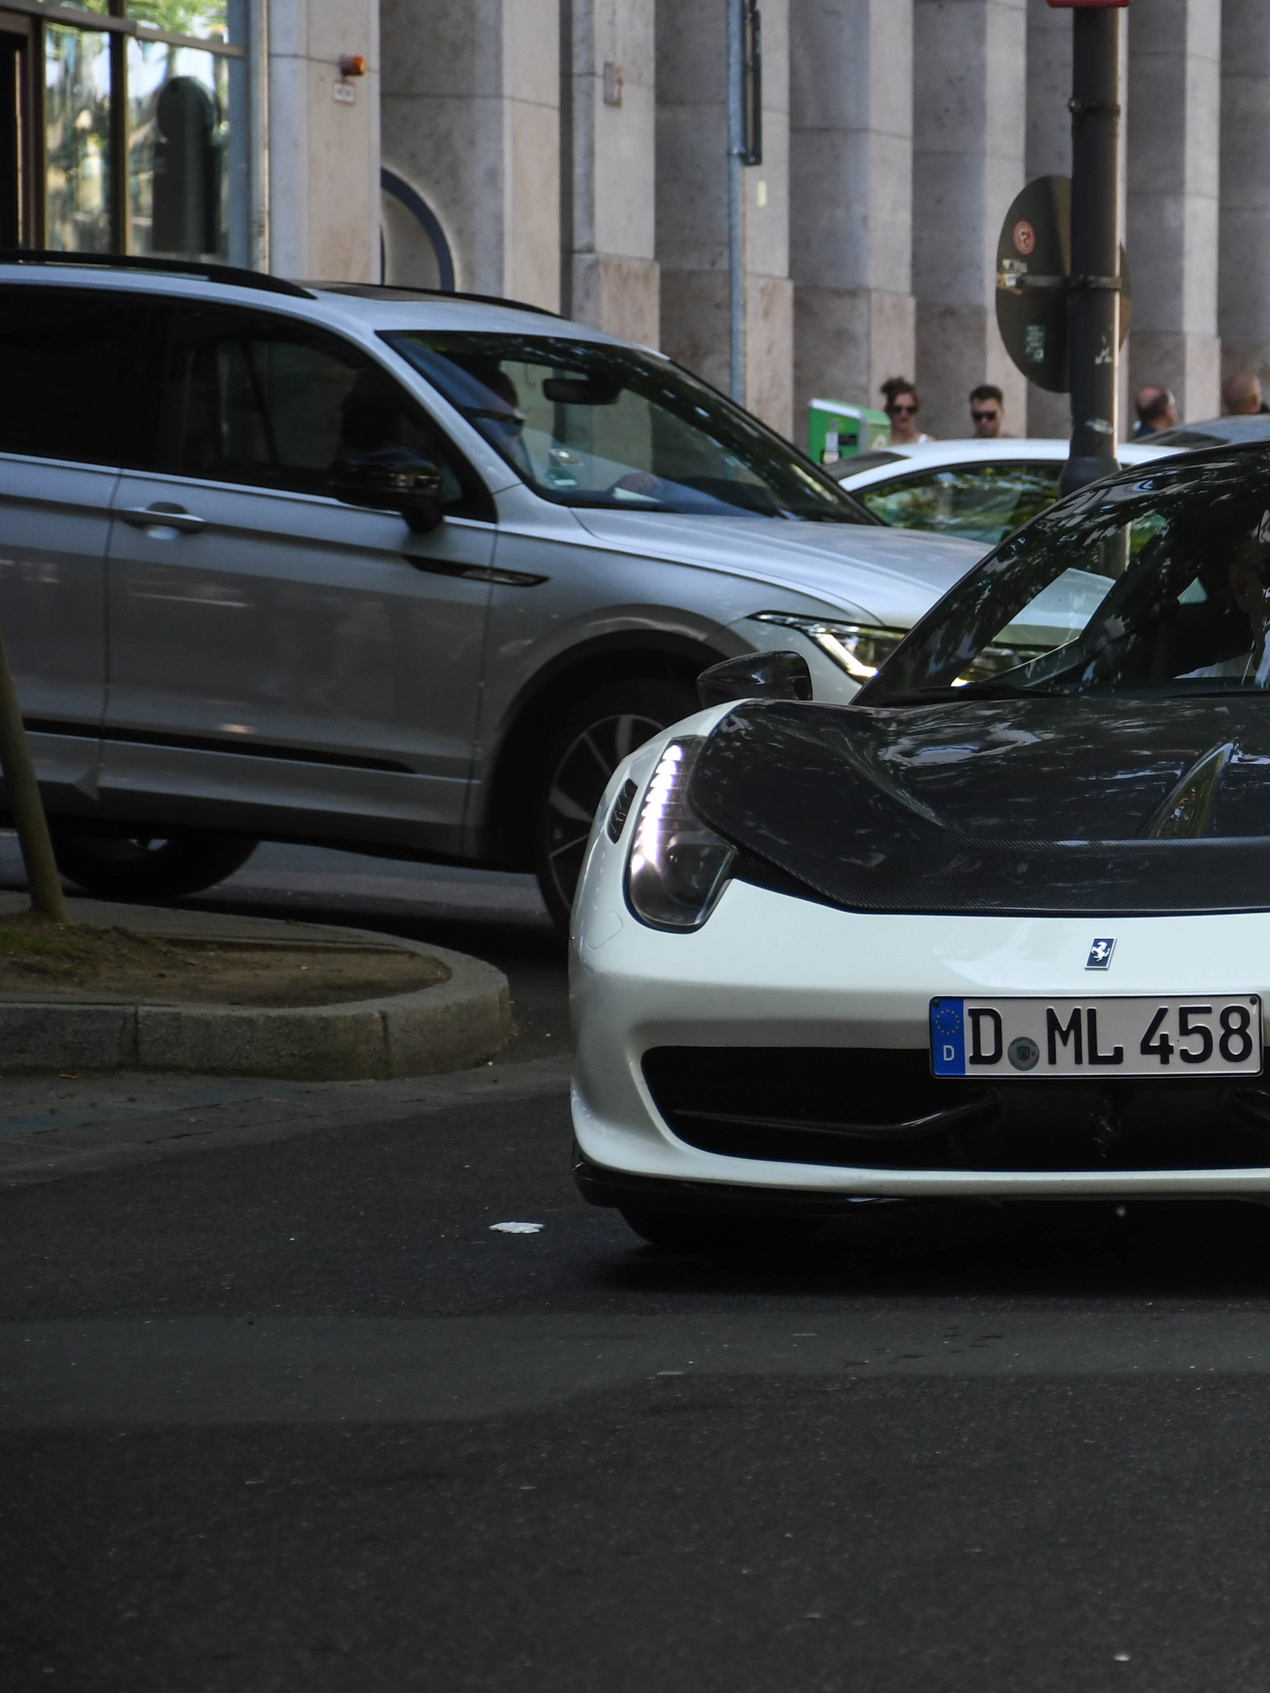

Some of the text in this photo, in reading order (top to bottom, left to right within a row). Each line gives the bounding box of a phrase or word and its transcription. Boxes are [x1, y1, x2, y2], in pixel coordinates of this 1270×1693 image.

[943, 1045, 955, 1061] D
[968, 1005, 1253, 1065] D ML 458
